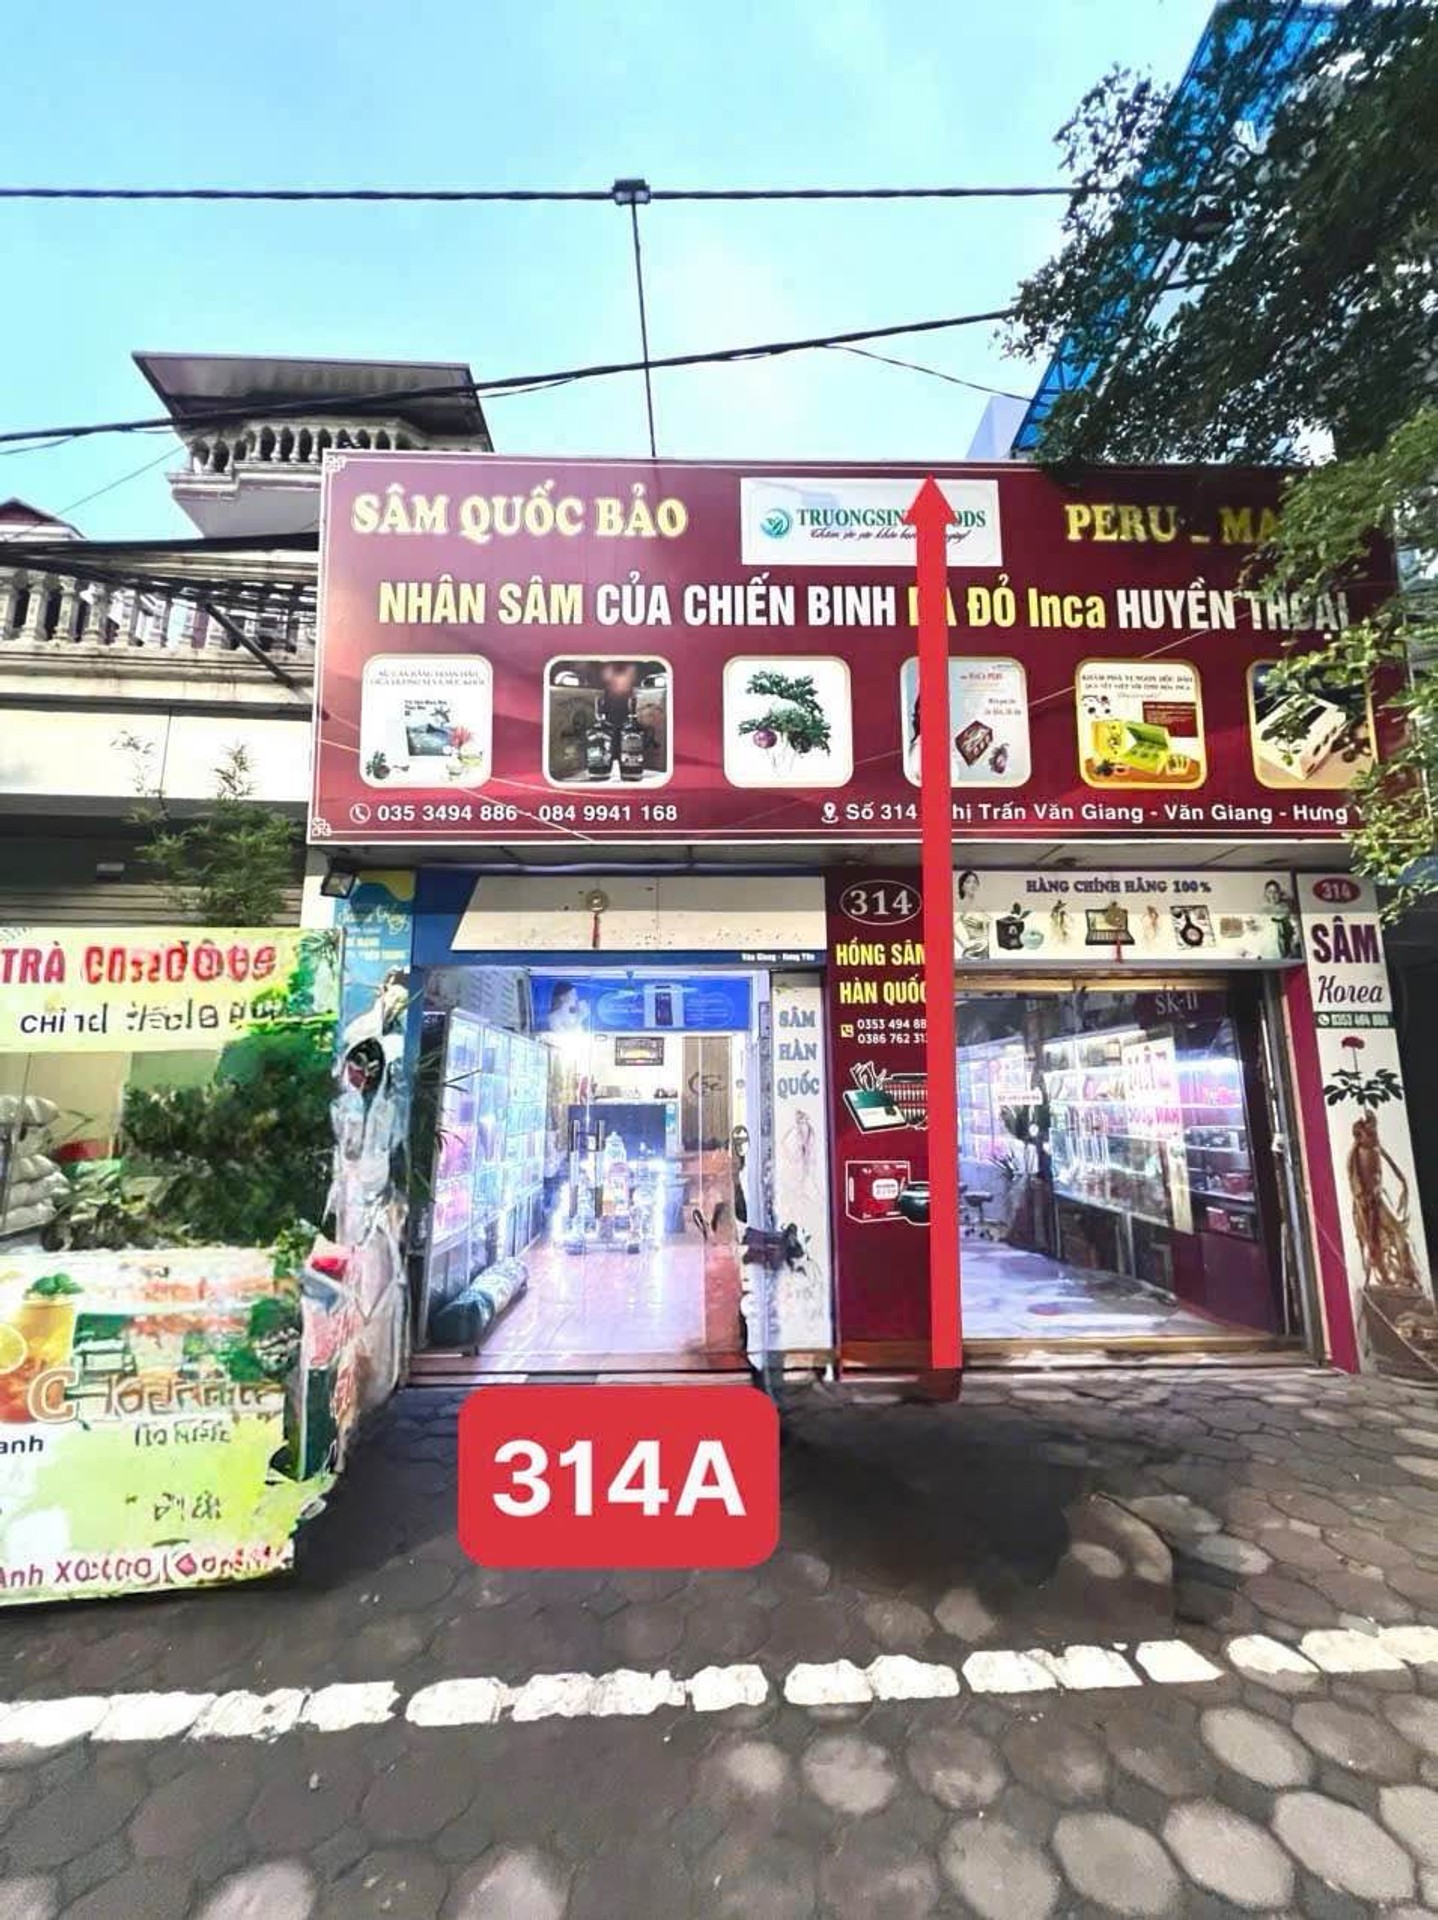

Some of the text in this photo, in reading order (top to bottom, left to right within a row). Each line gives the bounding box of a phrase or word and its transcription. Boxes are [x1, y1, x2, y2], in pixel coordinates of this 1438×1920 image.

[352, 479, 688, 544] SÂM QUỐC BẢO
[1064, 504, 1178, 543] PERU
[379, 573, 486, 624] NHÂN
[498, 575, 583, 625] SÂM
[596, 570, 672, 626] CỦA
[683, 571, 795, 626] CHIẾN
[807, 585, 896, 627] BINH
[967, 573, 1016, 628] ĐỎ
[1027, 587, 1106, 629] Inca
[1116, 576, 1236, 630] HUYỀN
[377, 804, 415, 821] 035
[422, 804, 472, 821] 3494
[480, 804, 518, 821] 886
[539, 804, 576, 822] 084
[583, 804, 631, 821] 9941
[641, 804, 678, 821] 168
[846, 801, 874, 820] Số
[881, 804, 917, 820] 314
[953, 804, 973, 823] hị
[979, 801, 1026, 820] Trấn
[1034, 804, 1073, 820] Văn
[1081, 803, 1144, 824] Giang
[1164, 804, 1204, 821] Văn
[1211, 804, 1273, 824] Giang
[1293, 804, 1348, 825] Hưng
[1026, 877, 1069, 893] HÀNG
[1073, 877, 1121, 893] CHÍNH
[850, 889, 912, 915] 314
[836, 937, 886, 966] HỒNG
[1311, 915, 1380, 964] SÂM
[0, 941, 66, 984] TRÀ
[839, 977, 878, 1004] HÀN
[1318, 975, 1384, 1004] Korea
[20, 1007, 65, 1033] CHỈ
[779, 1006, 817, 1028] SÂM
[778, 1039, 817, 1060] HÀN
[777, 1070, 820, 1098] QUỐC
